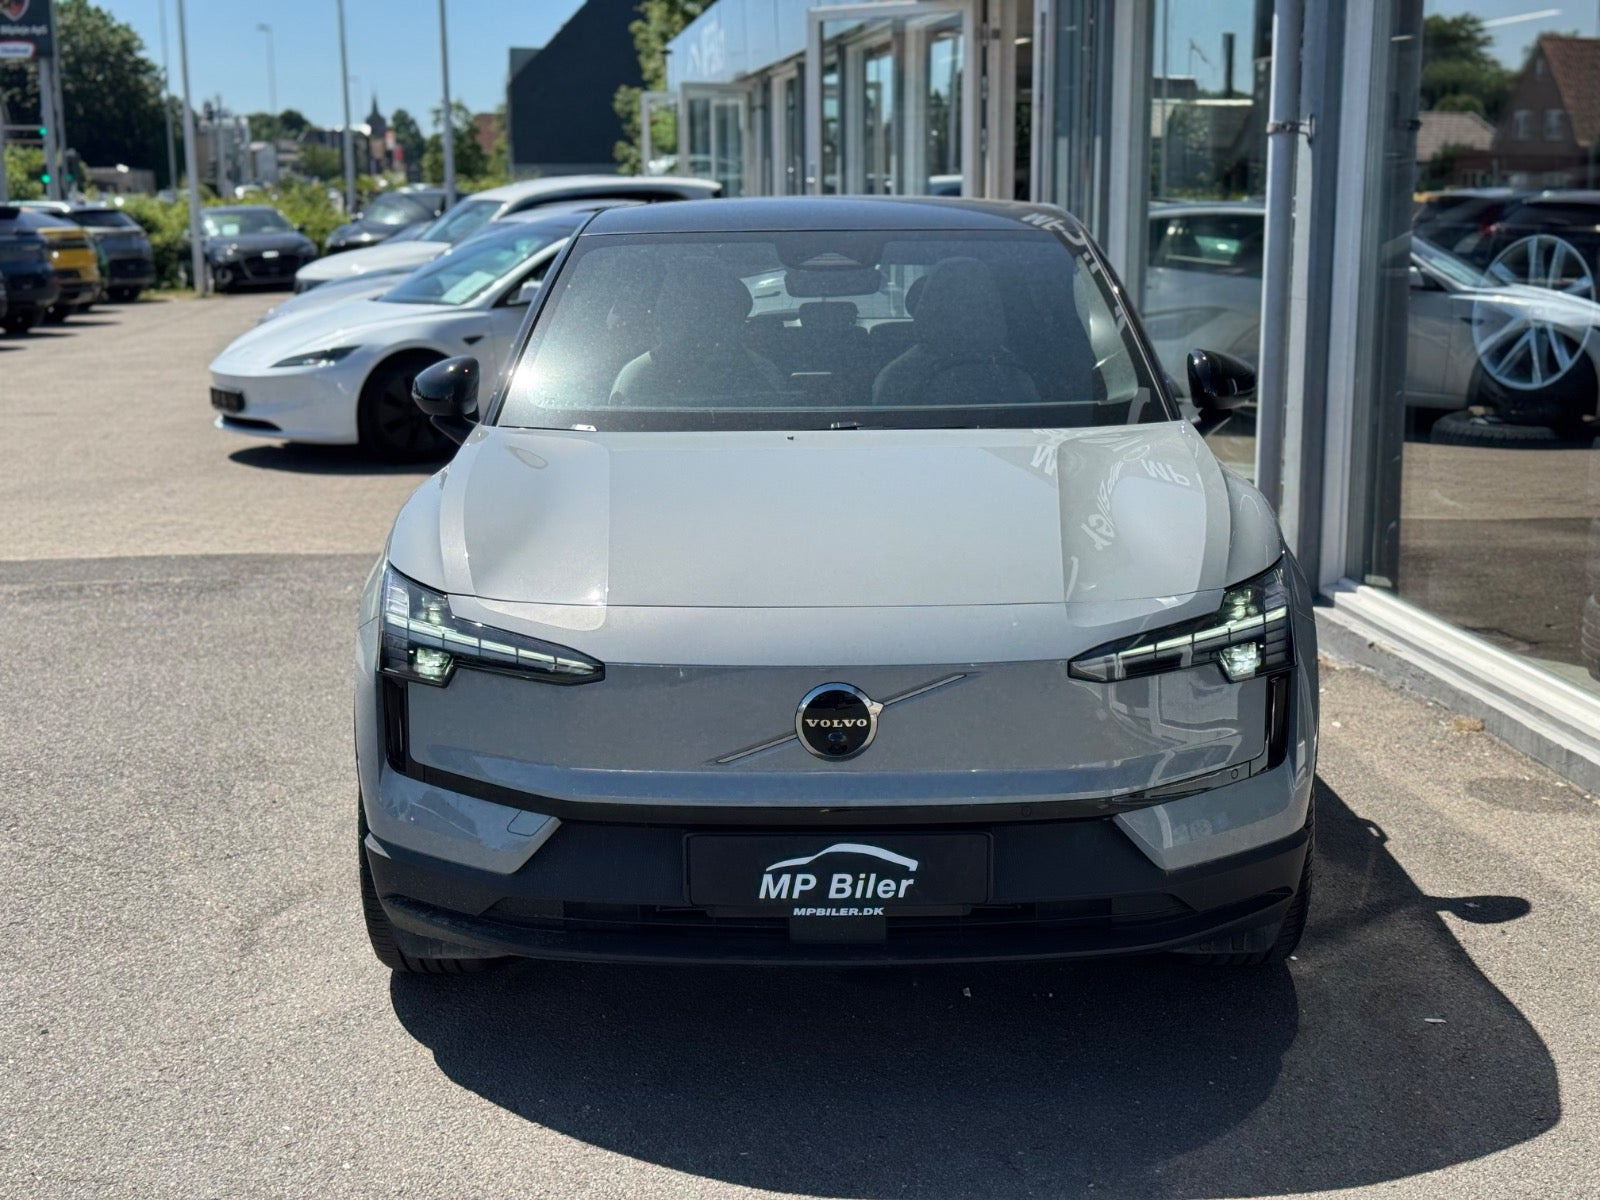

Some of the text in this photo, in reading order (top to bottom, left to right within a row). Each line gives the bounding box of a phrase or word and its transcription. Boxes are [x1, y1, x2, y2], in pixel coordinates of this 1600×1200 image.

[805, 718, 868, 728] VOLVO
[758, 873, 915, 899] MP Biler
[793, 907, 885, 917] MPBILER.DK
